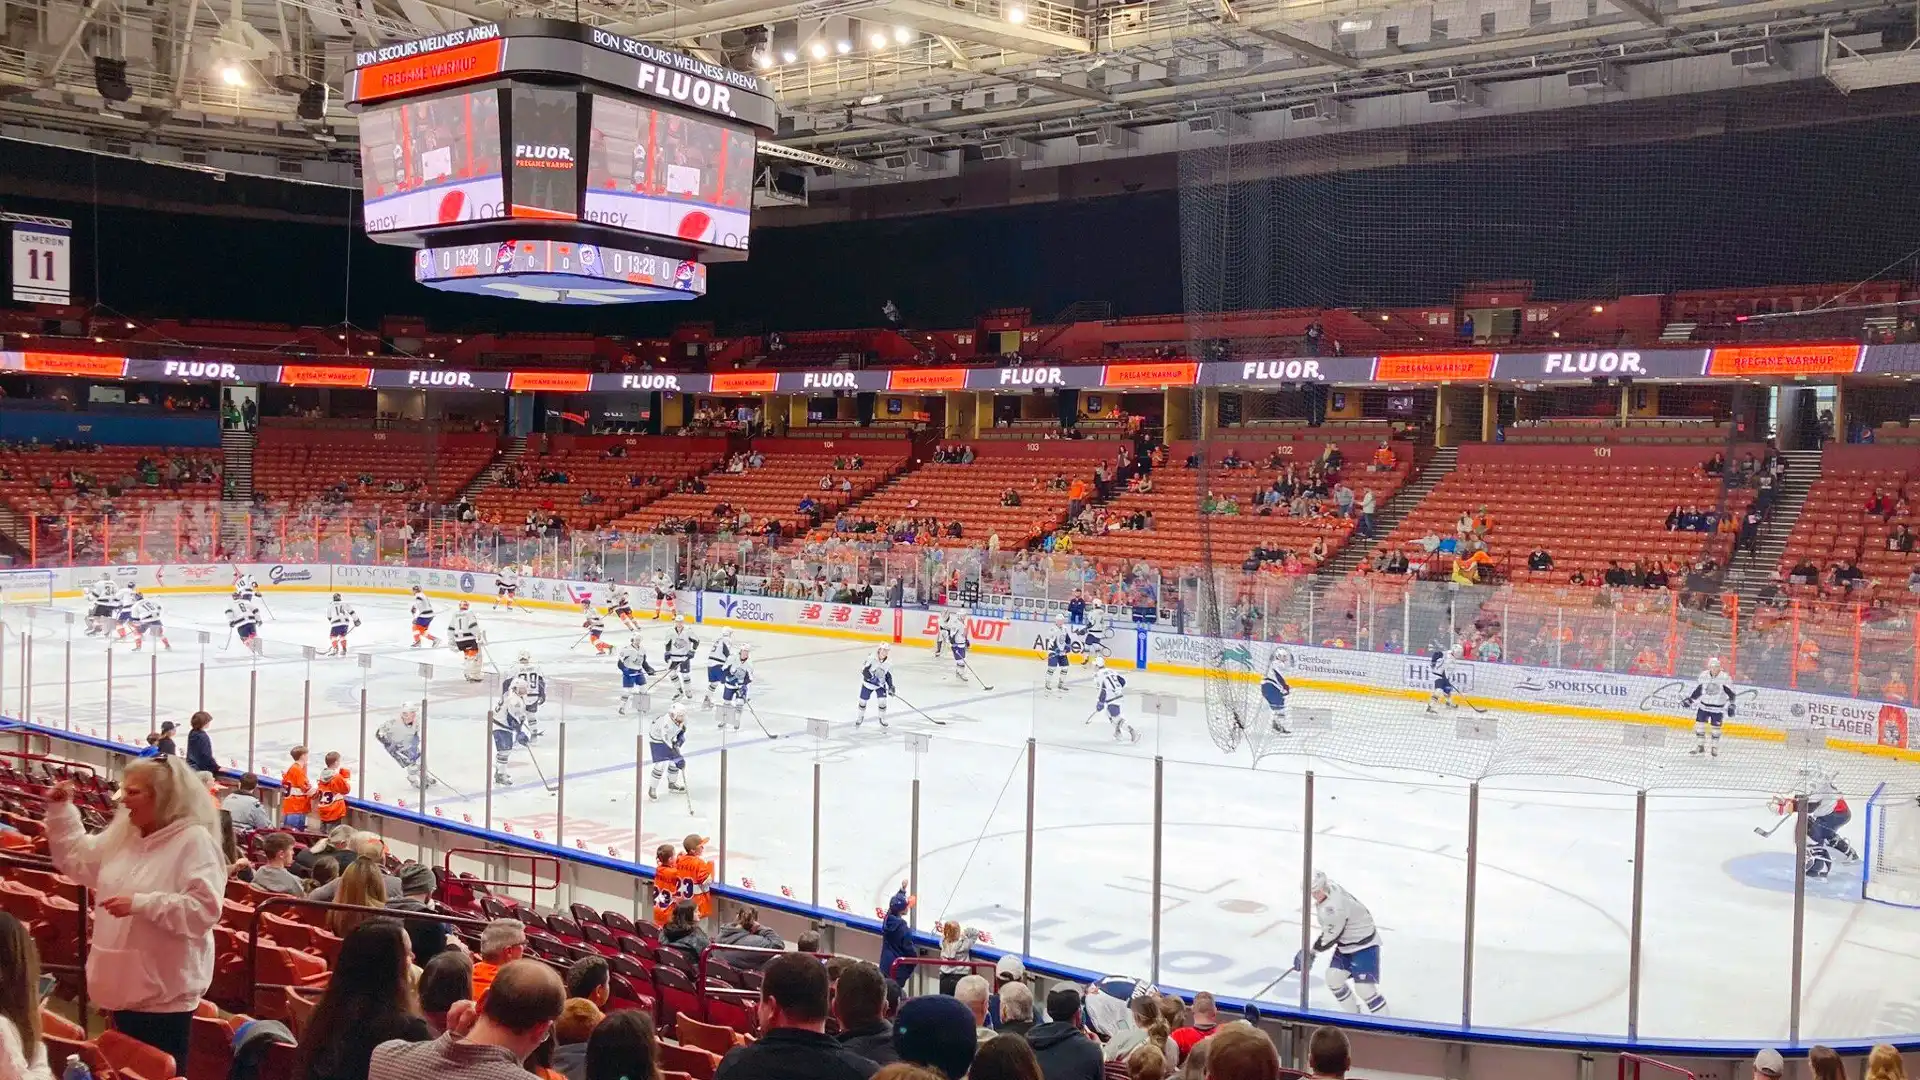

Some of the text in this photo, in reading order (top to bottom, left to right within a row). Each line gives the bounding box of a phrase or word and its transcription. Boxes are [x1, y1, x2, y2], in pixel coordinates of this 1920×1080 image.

[356, 23, 500, 66] BON SECOURS WELLNESS ARENA
[593, 29, 758, 91] BON SECOURS WELLNESS ARENA
[382, 56, 477, 88] PREGAME WARMUP
[516, 160, 574, 169] PREGAME WARMUP
[28, 249, 55, 281] 11
[455, 248, 479, 266] 13:28
[628, 255, 656, 276] 13:28
[1734, 356, 1834, 367] PREGAME WARMUP
[1277, 446, 1293, 455] 102
[1594, 447, 1611, 457] 101
[736, 607, 774, 622] Secours
[742, 600, 762, 612] Bon
[1164, 650, 1200, 662] MOVING
[1548, 680, 1628, 696] SPORTSCLUB
[1808, 703, 1875, 721] RISE GUYS
[1810, 715, 1872, 736] P1 LAGER
